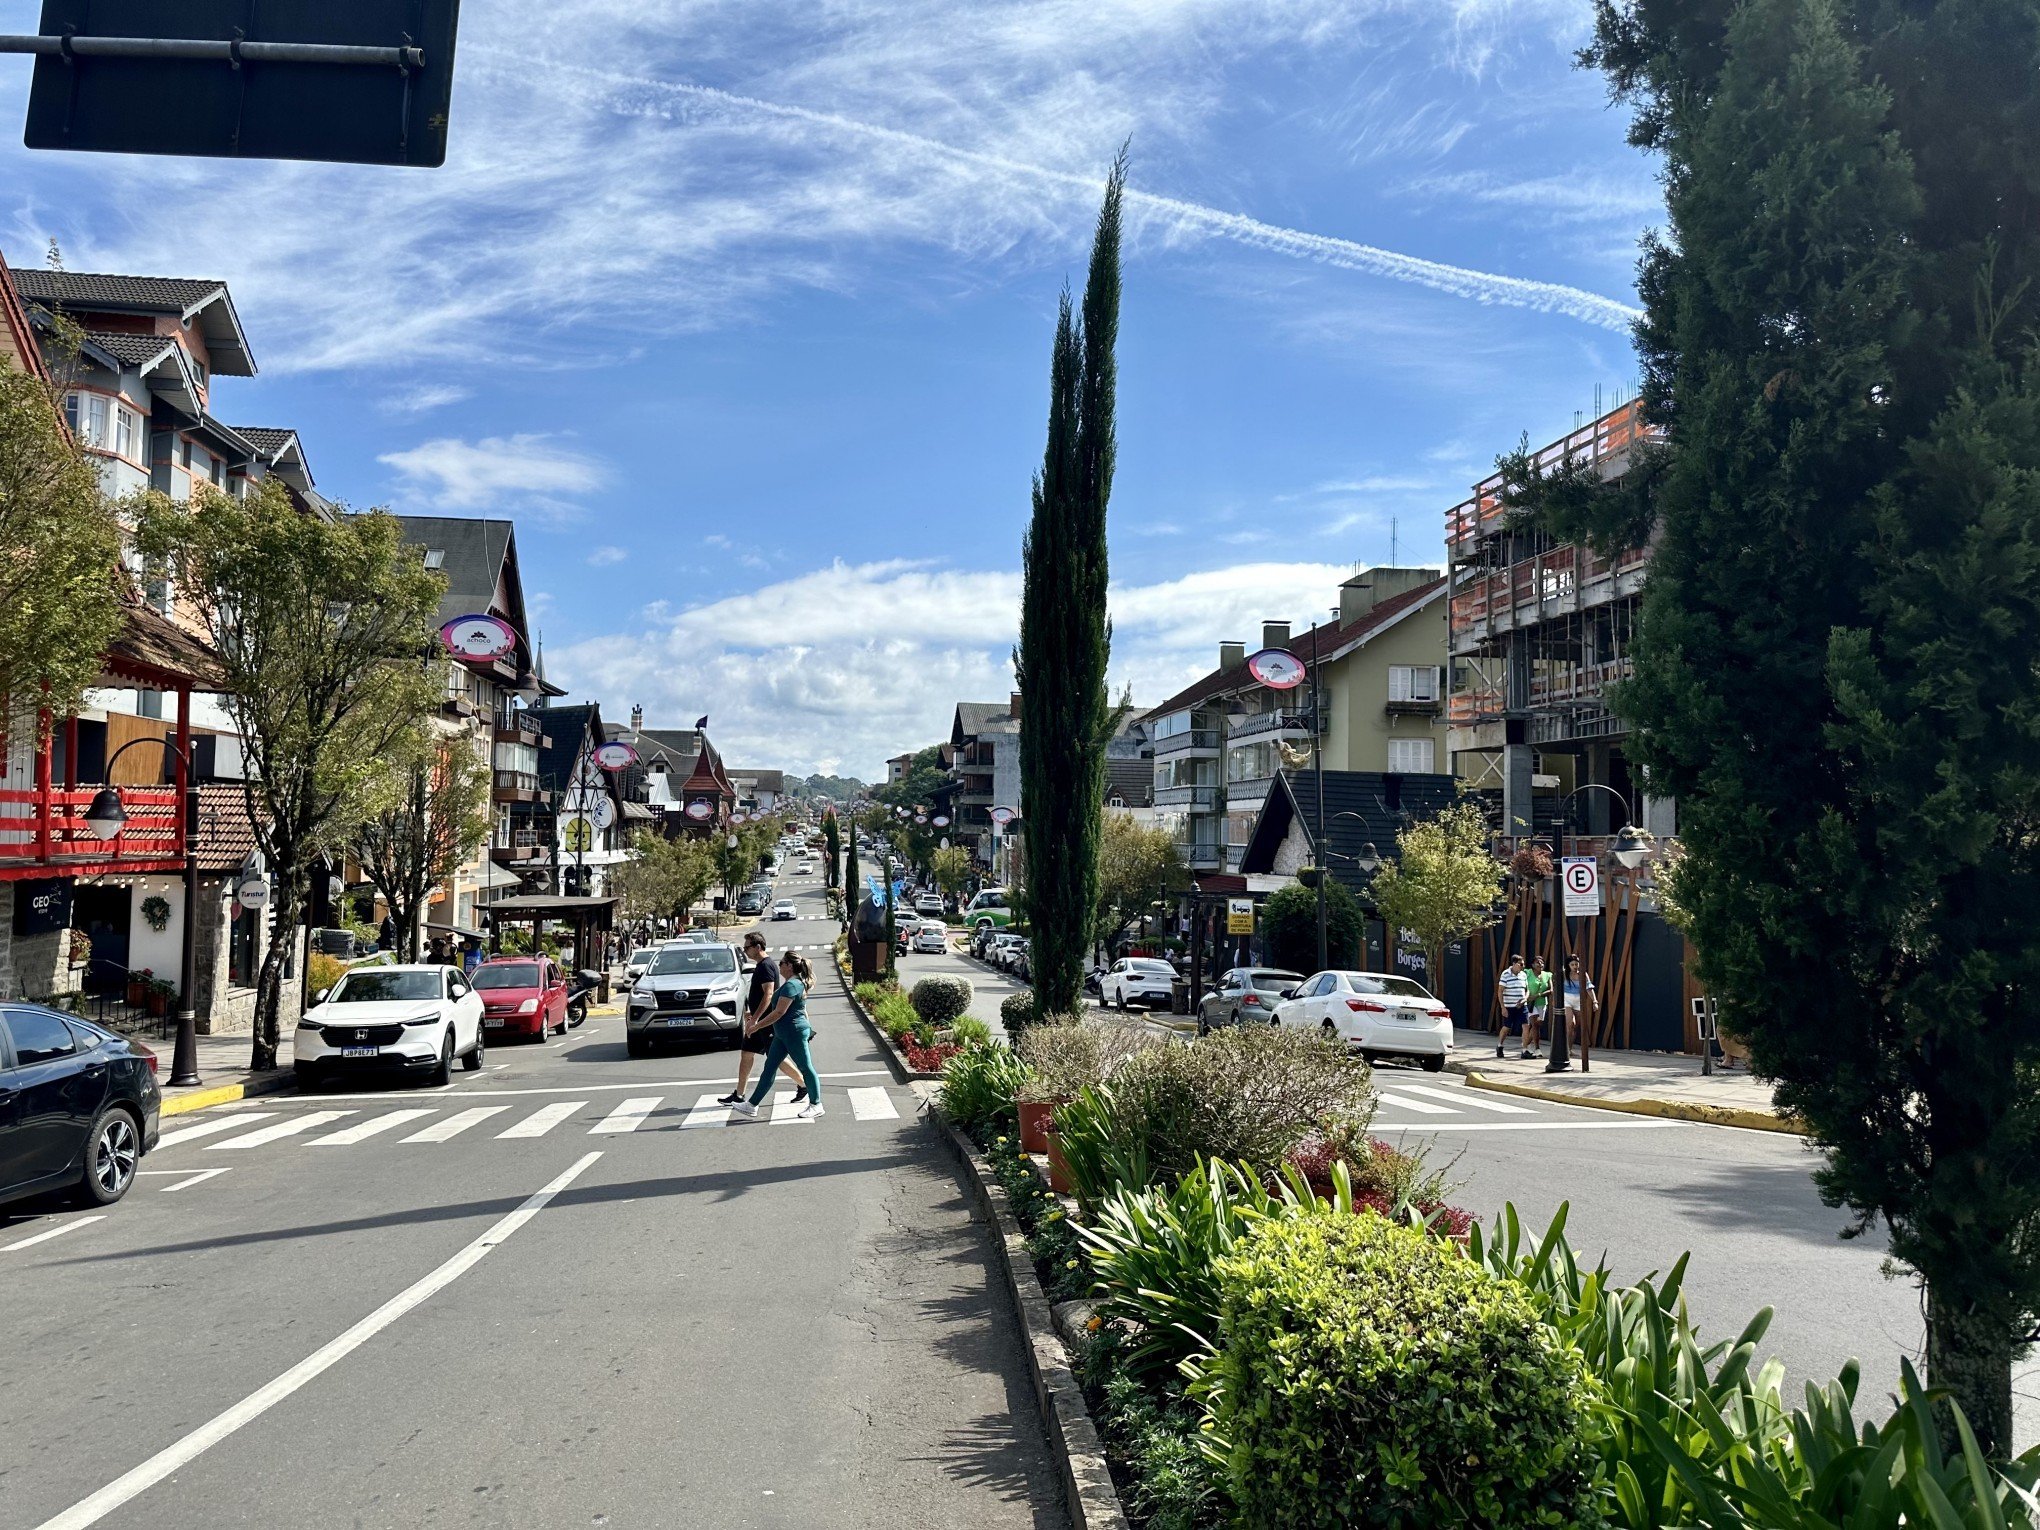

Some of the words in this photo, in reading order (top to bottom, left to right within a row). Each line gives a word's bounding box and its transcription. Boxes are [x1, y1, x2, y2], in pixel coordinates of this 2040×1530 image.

[1575, 870, 1585, 887] E
[32, 895, 50, 908] GEO
[1397, 948, 1426, 971] Borges
